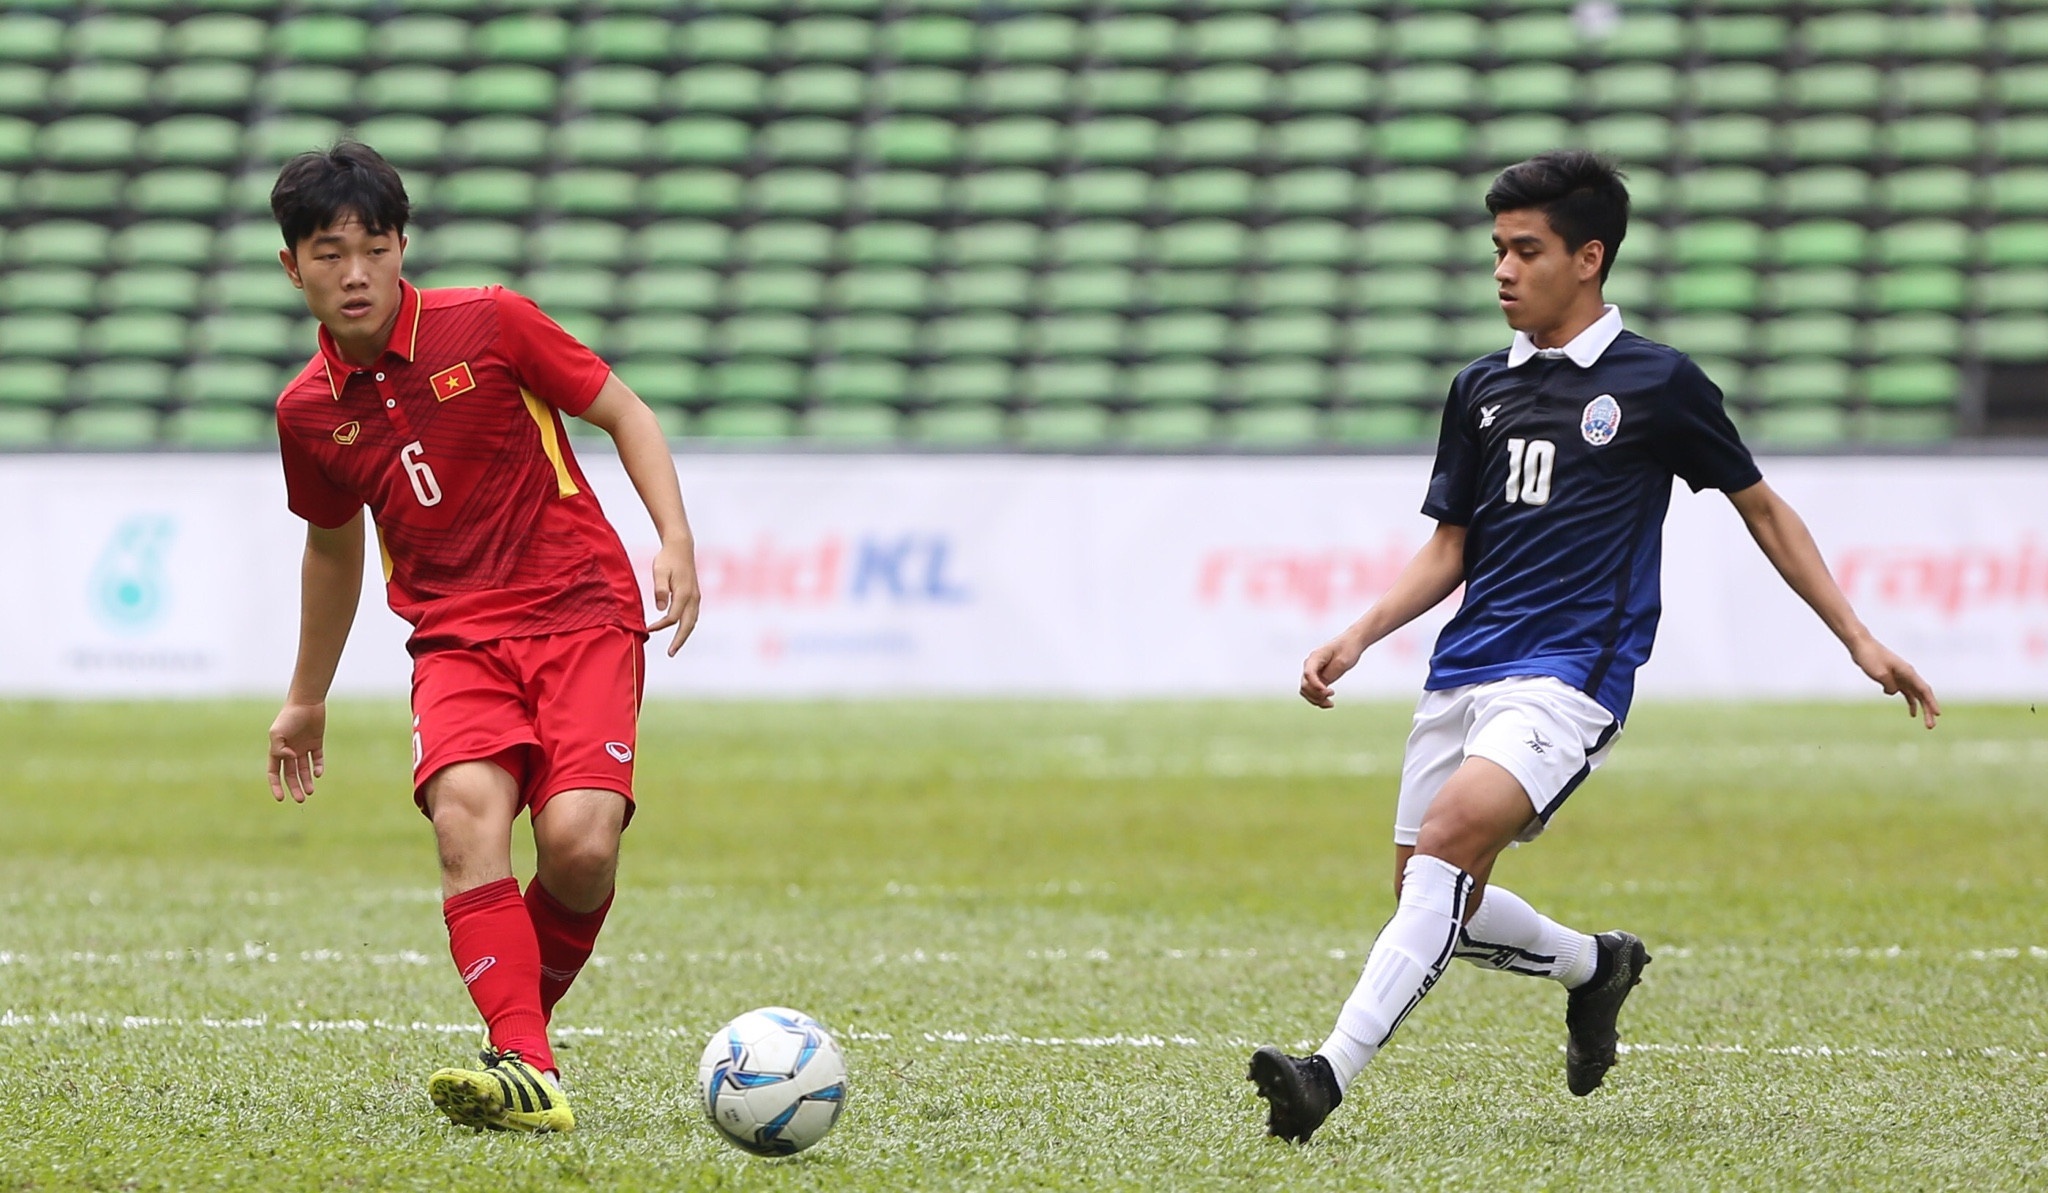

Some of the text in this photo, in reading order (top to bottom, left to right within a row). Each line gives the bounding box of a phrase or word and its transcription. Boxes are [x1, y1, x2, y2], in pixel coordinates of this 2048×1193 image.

[400, 440, 442, 507] 6
[1505, 438, 1556, 506] 10
[1836, 532, 2048, 622] rapi
